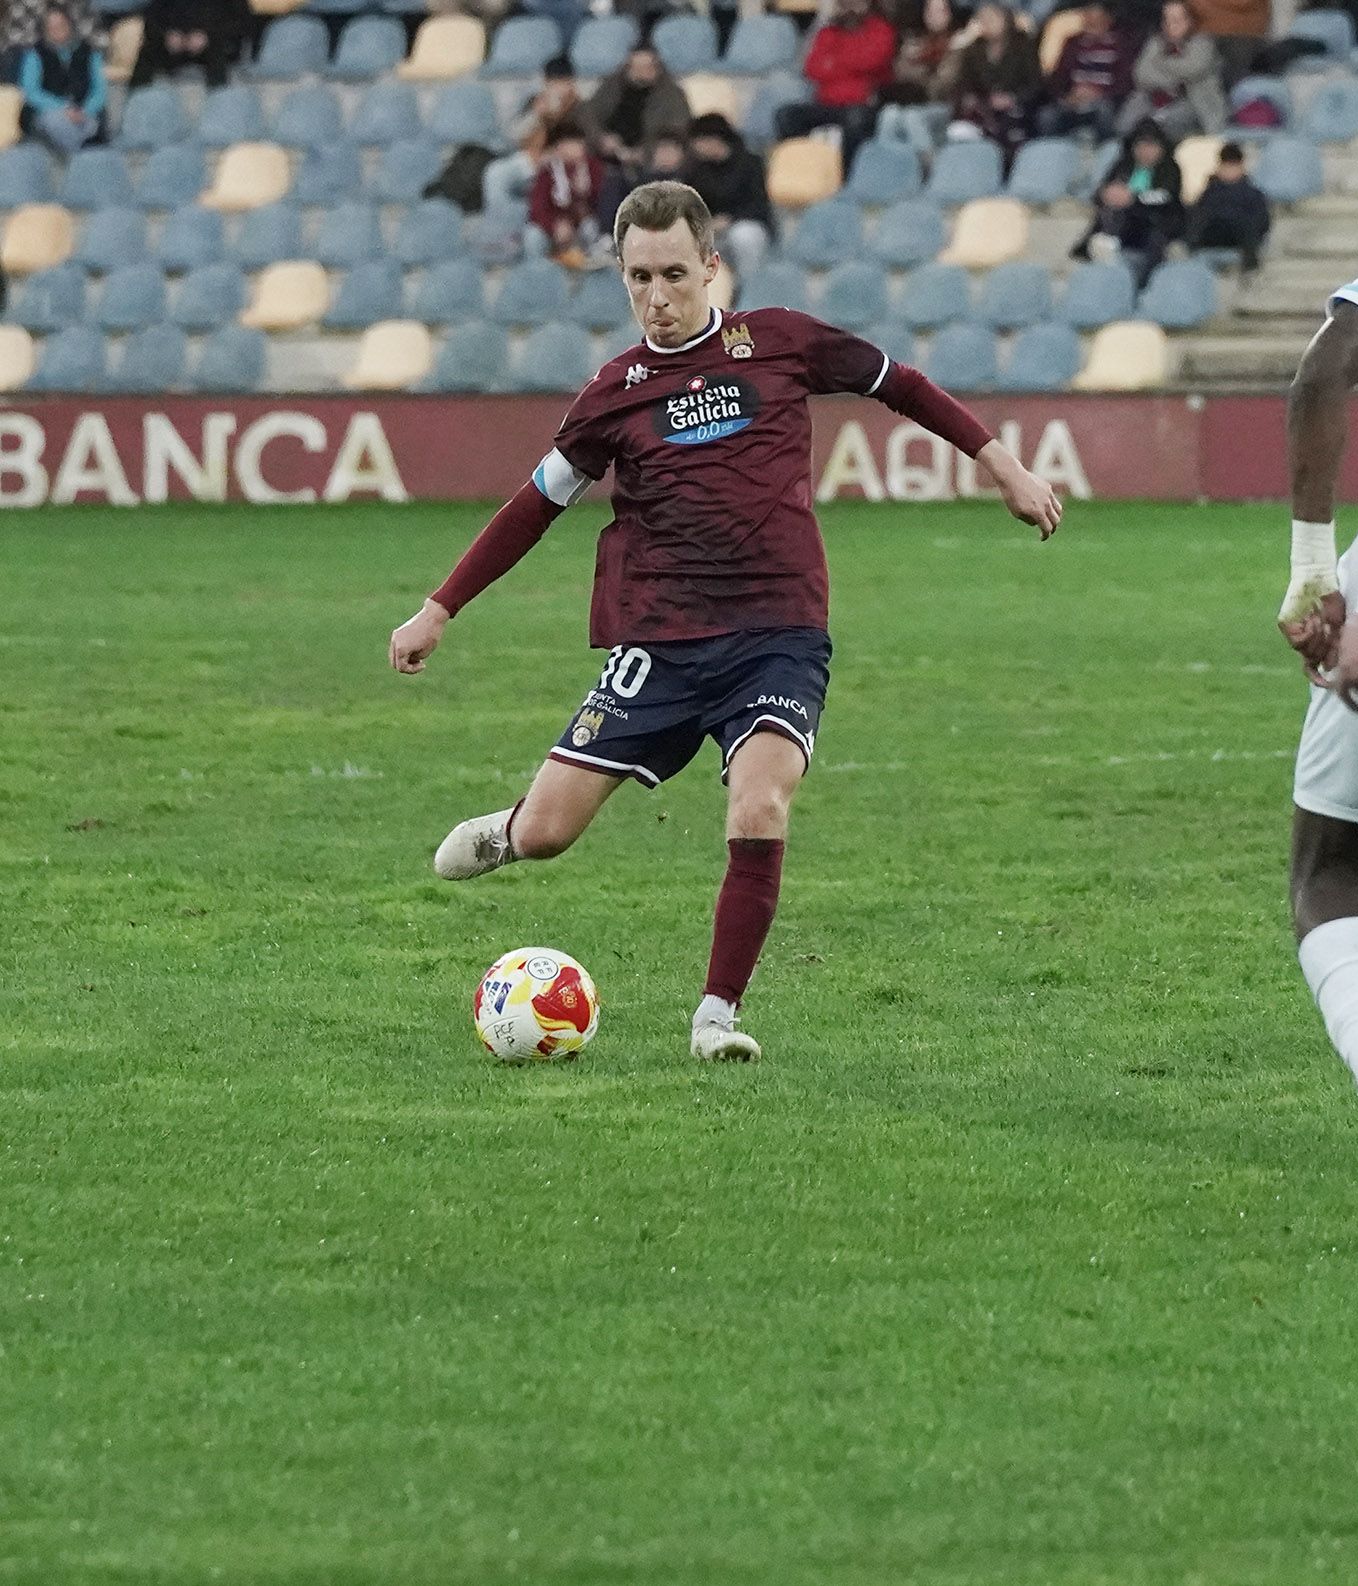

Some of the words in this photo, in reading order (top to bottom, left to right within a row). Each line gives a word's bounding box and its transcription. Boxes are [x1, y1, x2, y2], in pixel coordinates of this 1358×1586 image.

[670, 400, 741, 430] Galicia
[0, 411, 409, 508] BANCA
[600, 645, 652, 699] 10
[596, 701, 629, 721] GALICIA
[746, 694, 809, 720] BANCA
